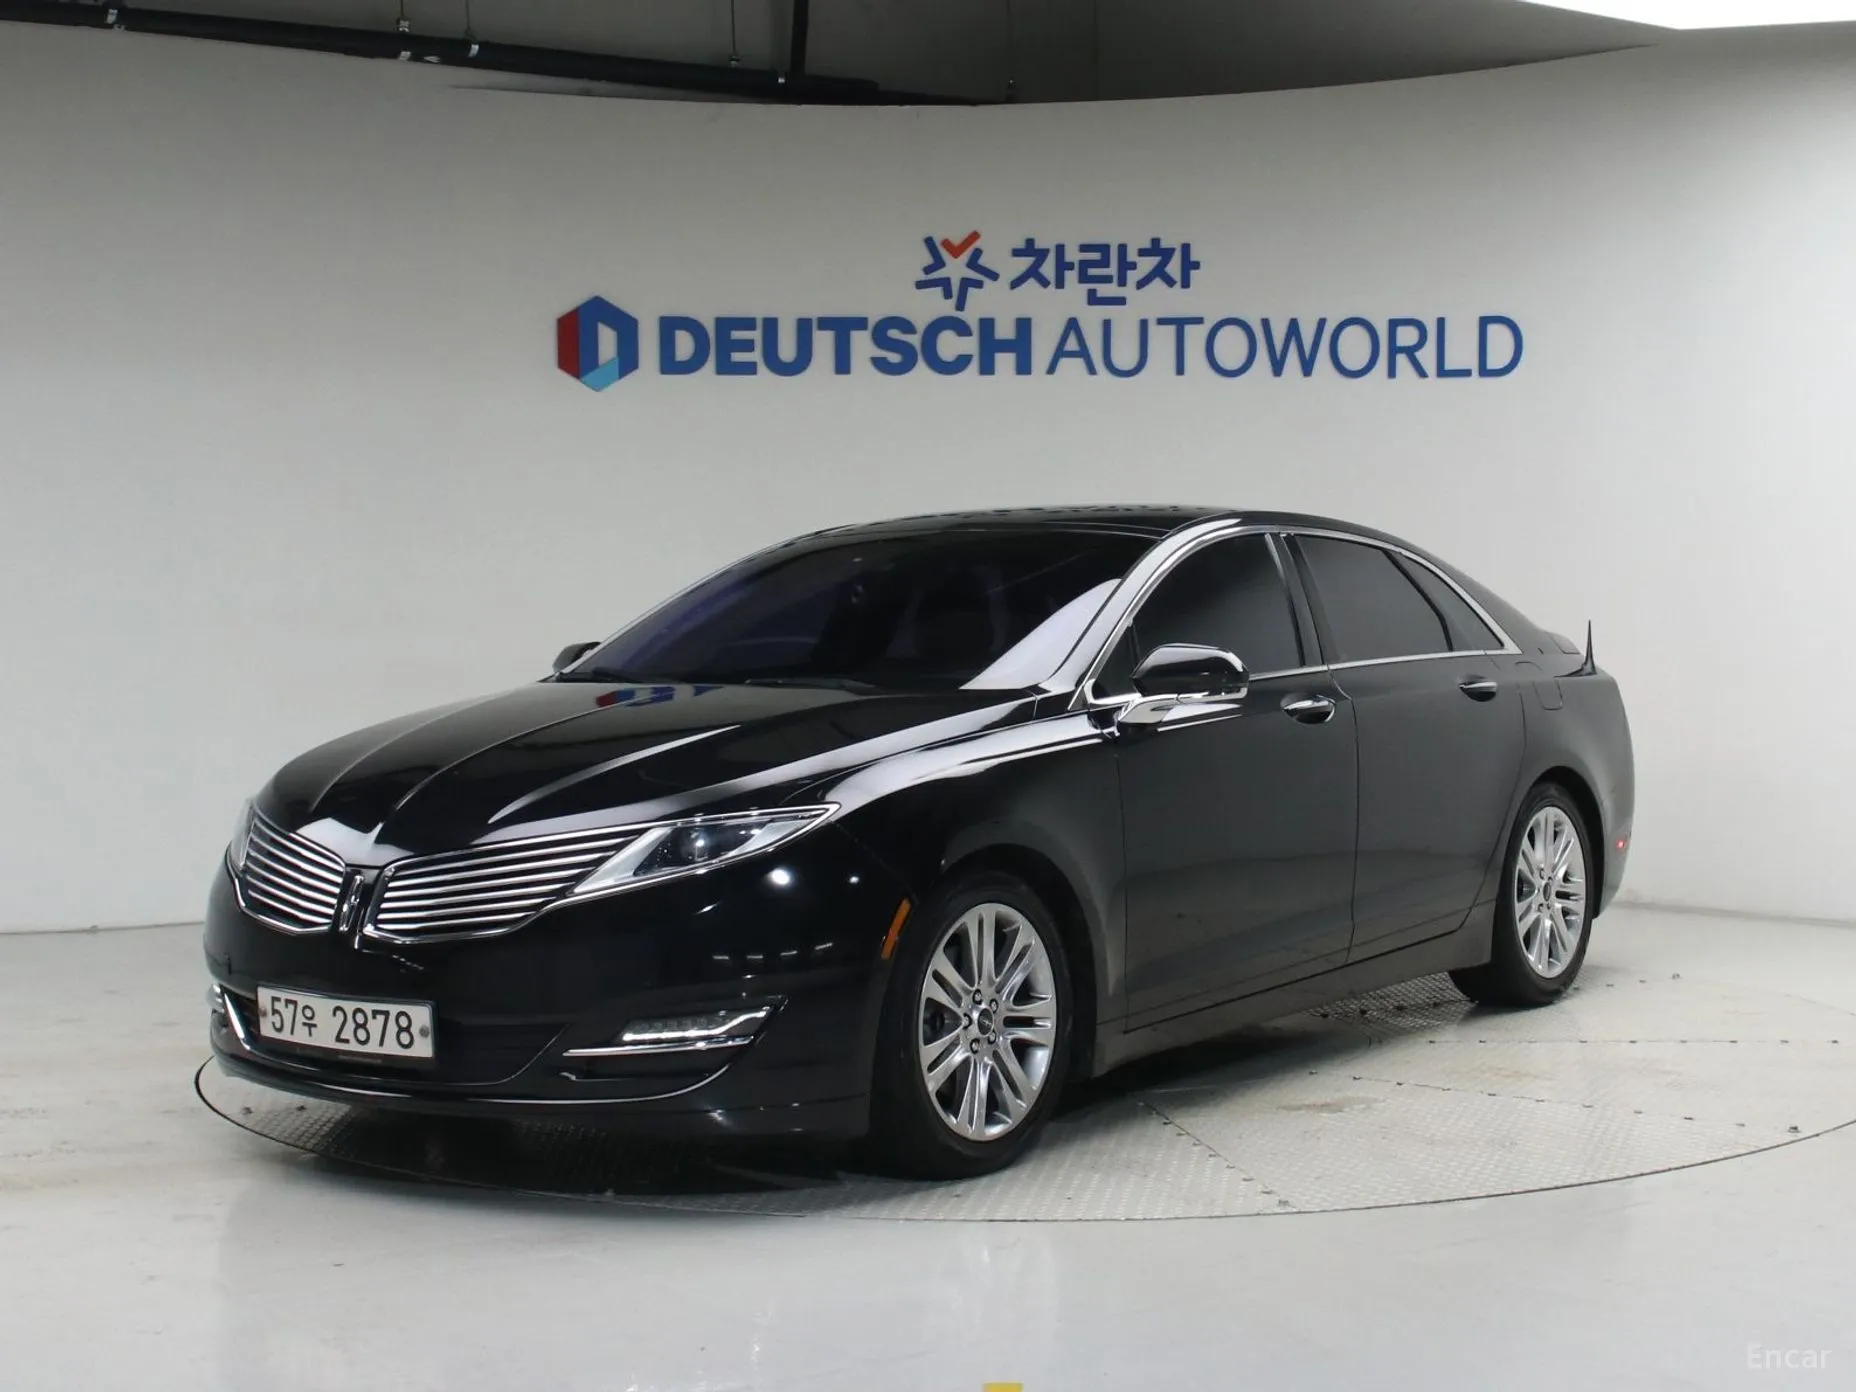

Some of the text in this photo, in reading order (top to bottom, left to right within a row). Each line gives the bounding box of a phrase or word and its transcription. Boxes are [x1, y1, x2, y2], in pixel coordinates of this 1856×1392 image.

[1012, 239, 1200, 307] 차란차
[658, 315, 1525, 380] DEUTSCH AUTOWORLD
[270, 995, 415, 1050] 57우 2878
